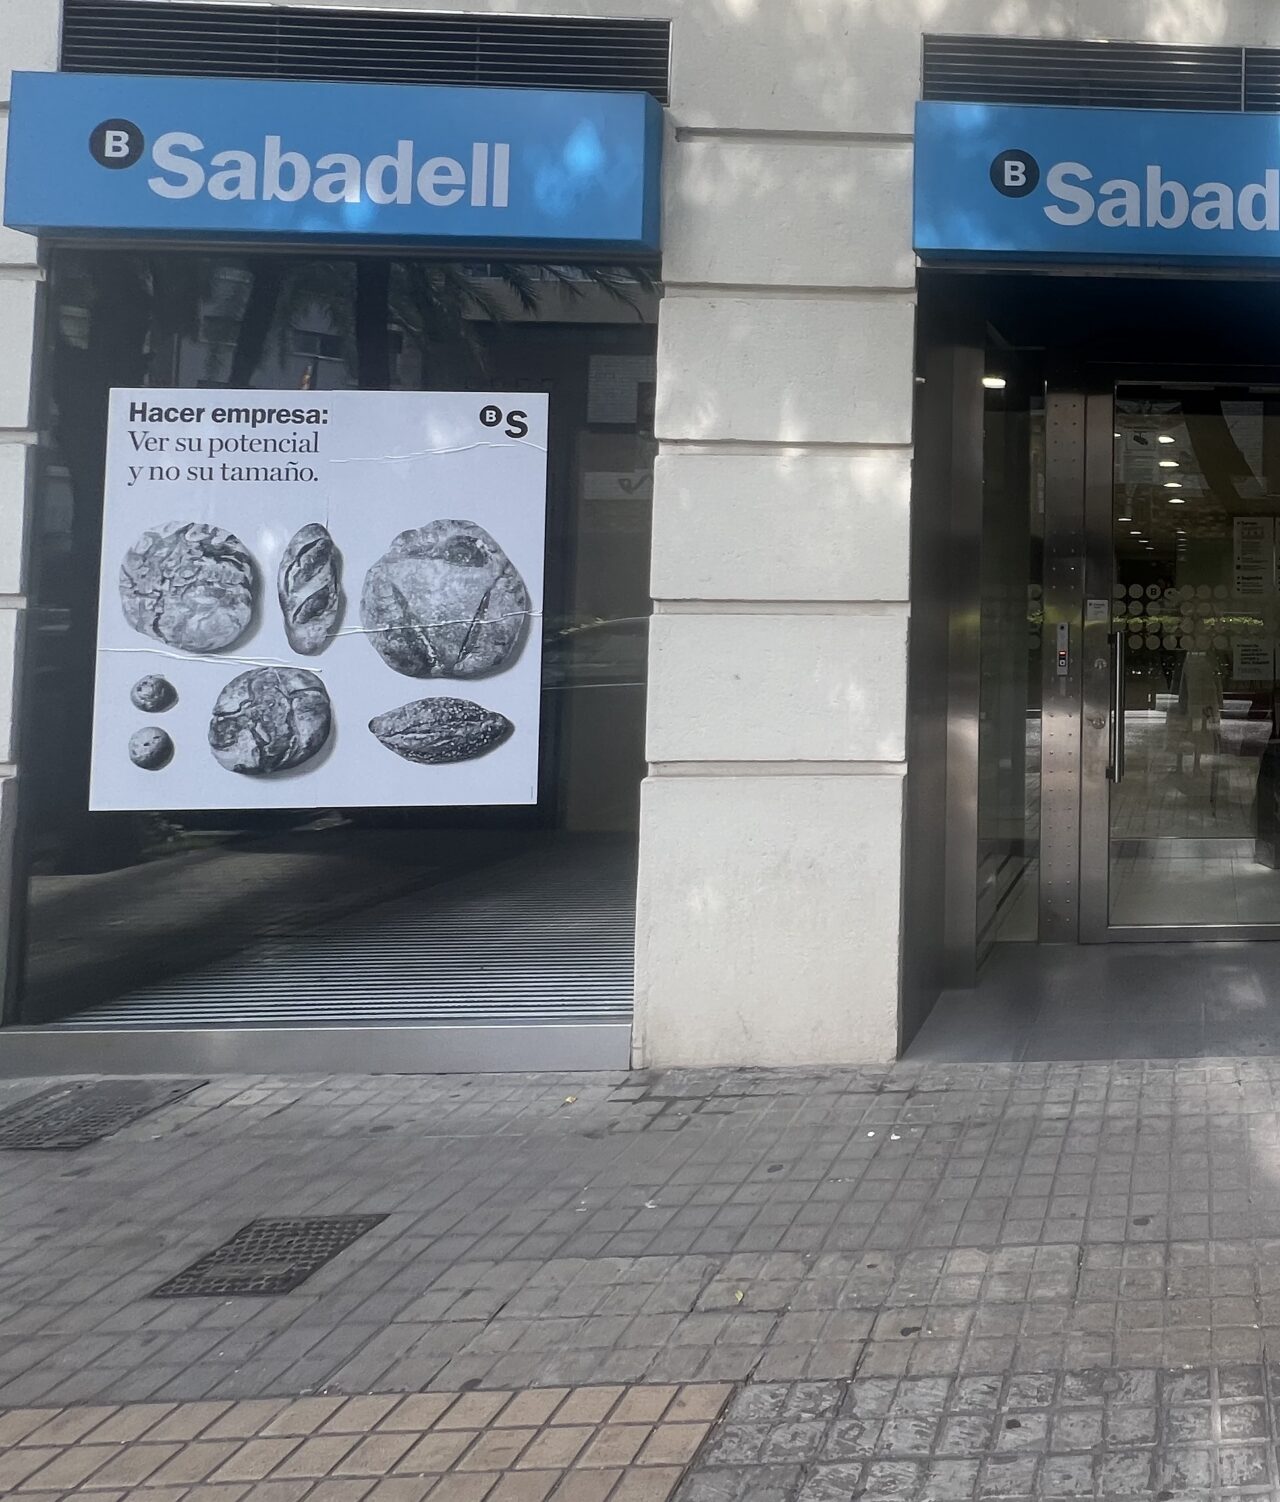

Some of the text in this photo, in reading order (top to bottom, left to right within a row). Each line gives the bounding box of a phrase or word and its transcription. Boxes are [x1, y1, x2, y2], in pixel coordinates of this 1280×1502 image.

[147, 131, 510, 208] Sabadell
[129, 401, 329, 428] Hacer empresa:
[504, 409, 529, 439] S
[127, 430, 320, 459] Ver su potencial
[127, 460, 319, 487] y no su tamaño.
